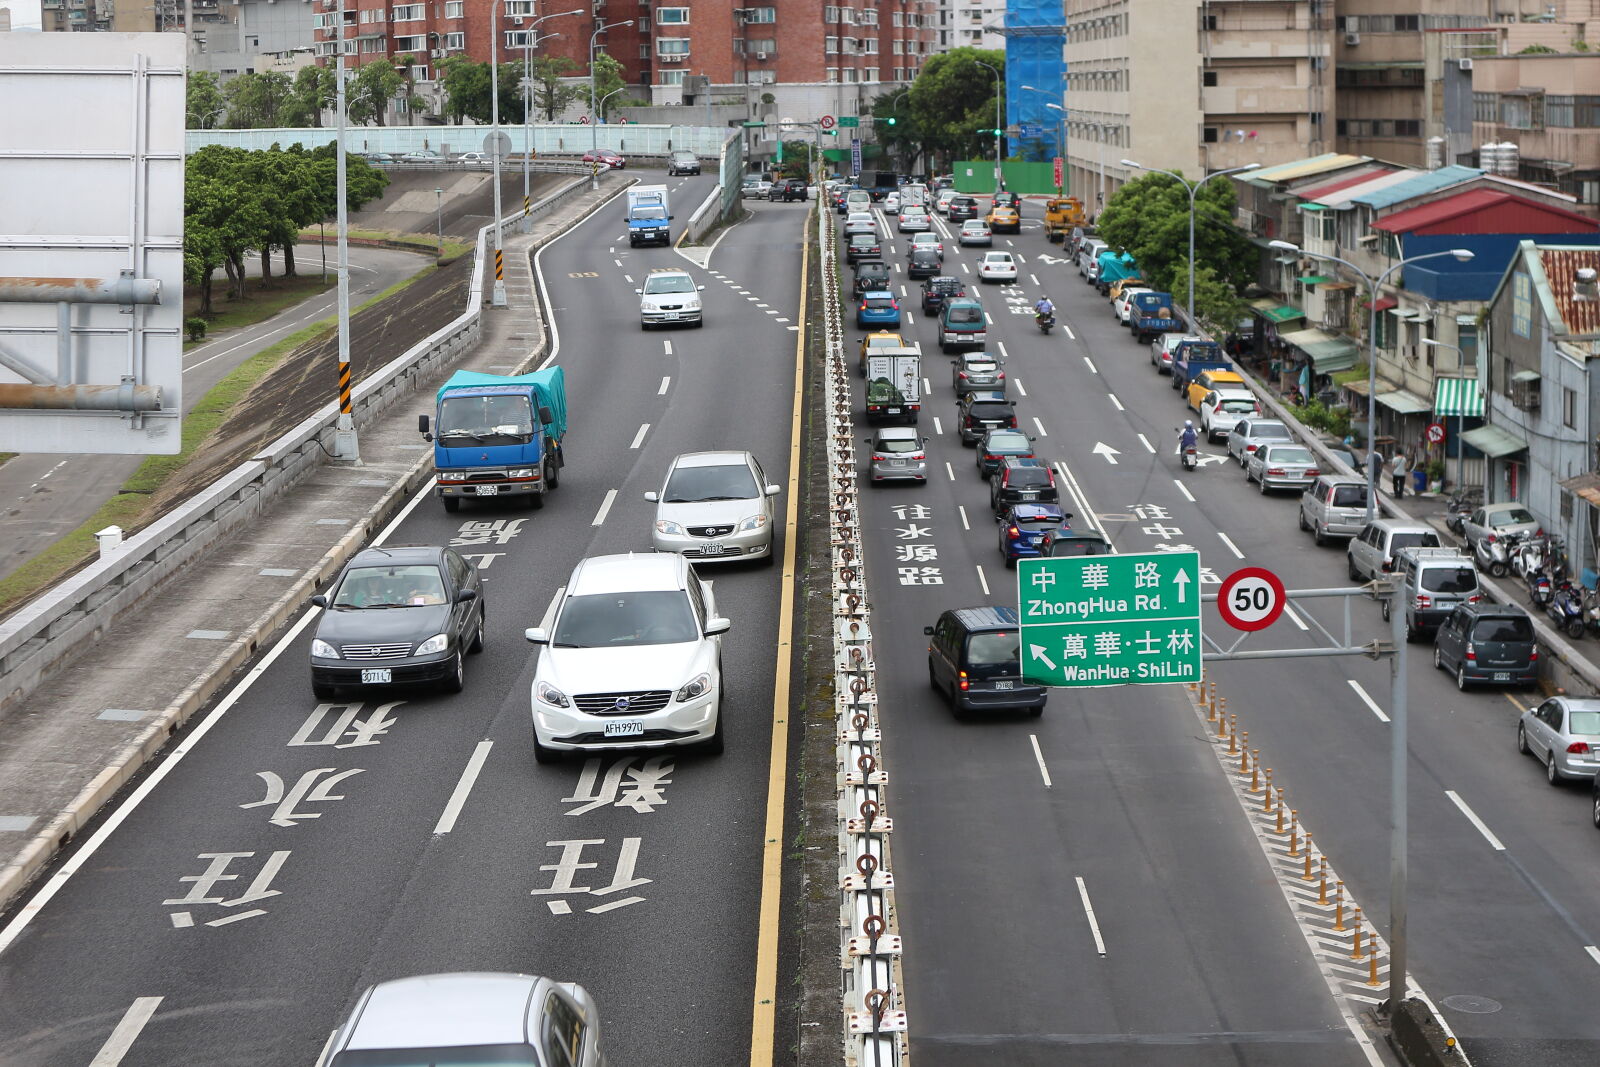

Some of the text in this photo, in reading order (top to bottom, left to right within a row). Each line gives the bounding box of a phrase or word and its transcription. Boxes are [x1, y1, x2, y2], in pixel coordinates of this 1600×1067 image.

[891, 504, 944, 586] 往水源路
[1031, 561, 1162, 593] 中華路
[1027, 594, 1167, 619] ZhongHua Rd.
[1235, 586, 1270, 612] 50
[161, 700, 409, 928] 往永和
